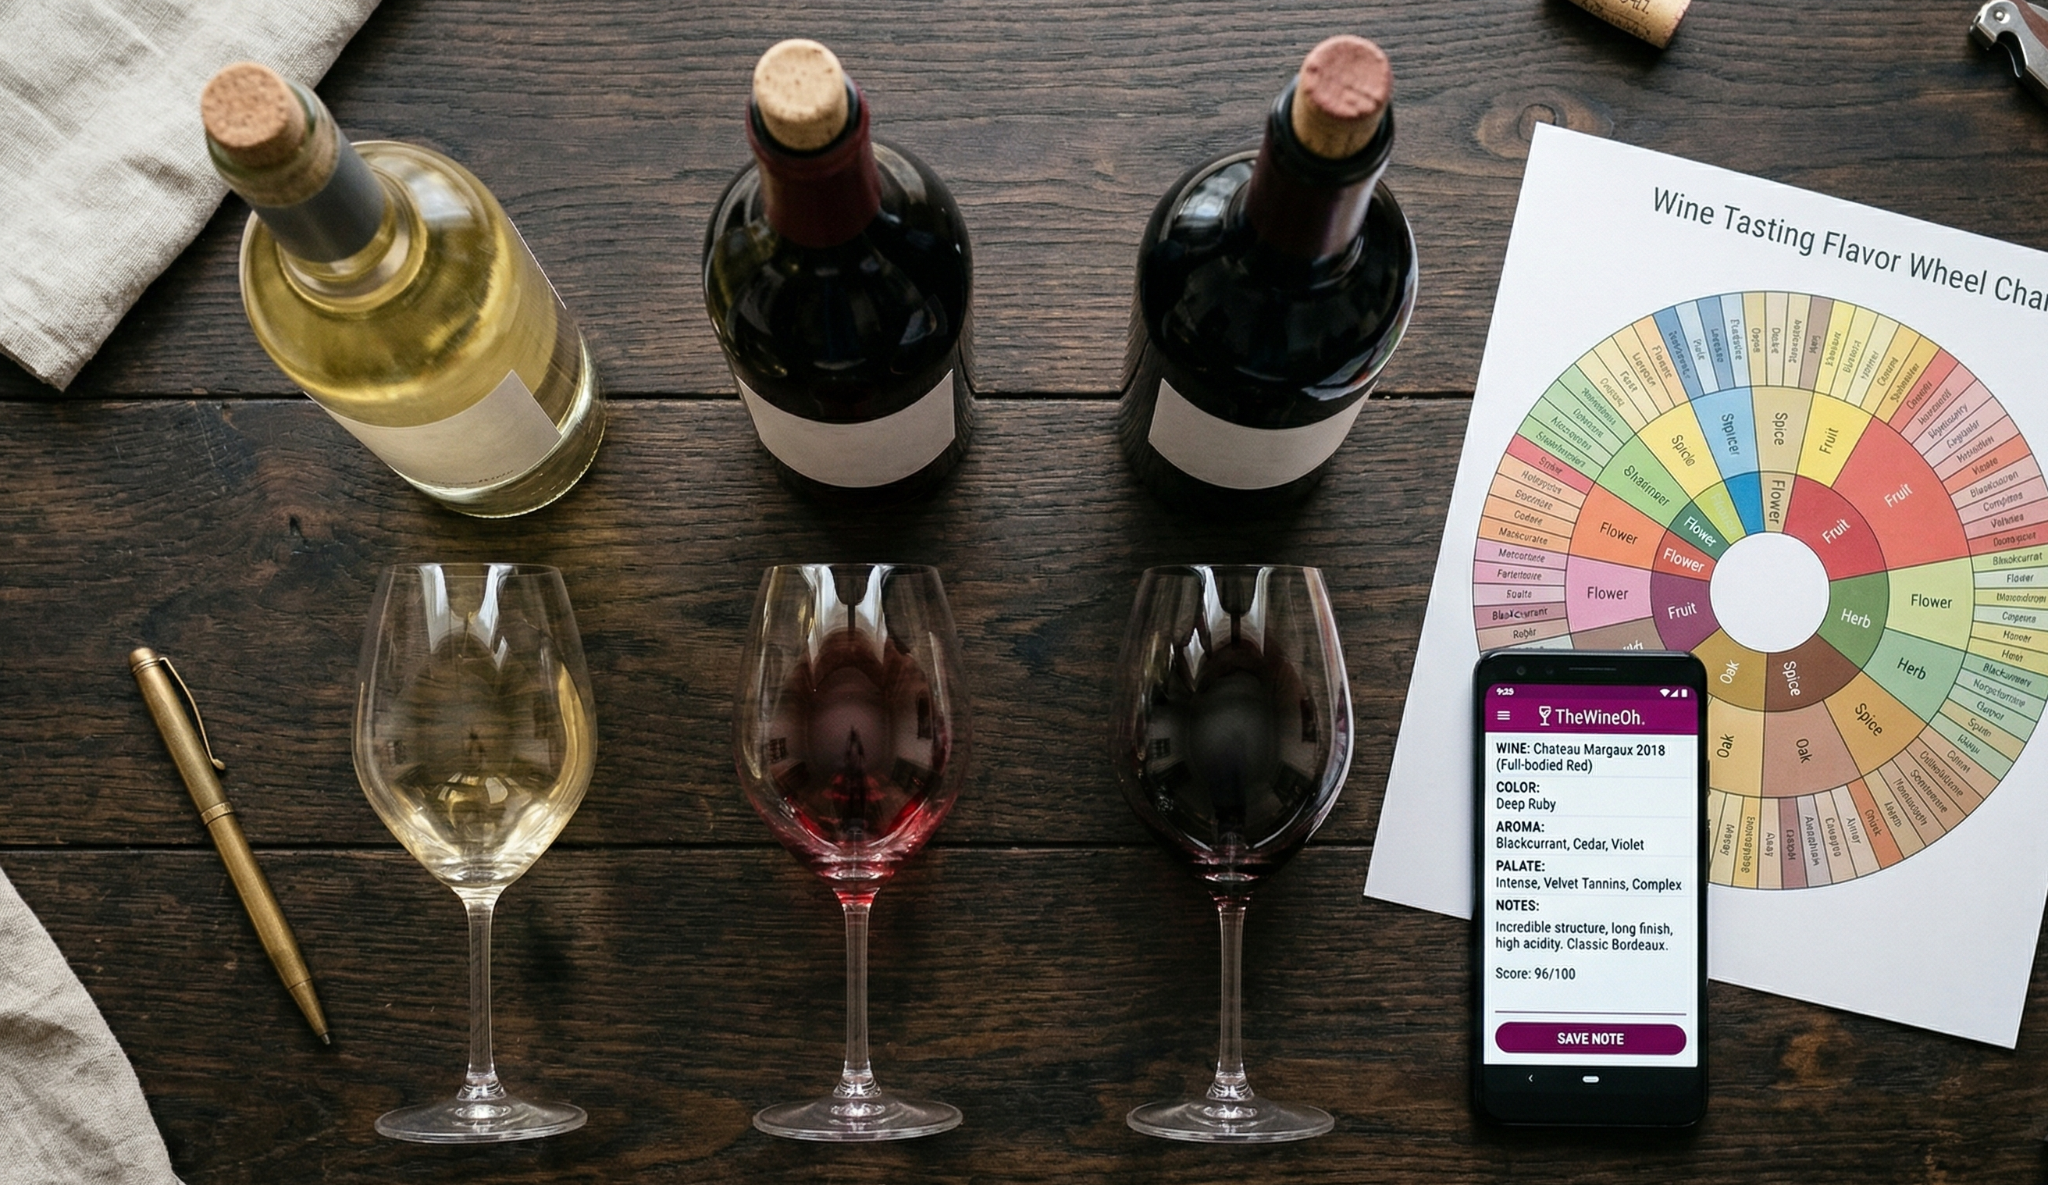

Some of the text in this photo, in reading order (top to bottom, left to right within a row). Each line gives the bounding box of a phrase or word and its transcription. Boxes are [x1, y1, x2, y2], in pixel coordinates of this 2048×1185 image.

[1653, 187, 1715, 227] Wine
[1724, 205, 1816, 257] Tasting
[1823, 231, 1901, 273] Flavor
[1910, 253, 1988, 296] Wheel
[1772, 412, 1788, 446] Spice
[1820, 427, 1838, 455] Fruit
[1769, 479, 1785, 525] Flower
[1884, 482, 1913, 508] Fruit
[1600, 522, 1638, 545] Flower
[1683, 515, 1717, 547] Flower
[1822, 518, 1851, 544] Fruit
[1663, 547, 1705, 573] Flower
[1587, 586, 1628, 600] Flower
[1911, 594, 1953, 609] Flower
[1668, 602, 1697, 620] Fruit
[1840, 609, 1871, 629] Herb
[1719, 659, 1740, 685] Oak
[1897, 657, 1927, 680] Herb
[1783, 660, 1801, 697] Spice
[1554, 708, 1646, 726] TheWineOh.
[1854, 703, 1883, 737] Spice
[1495, 742, 1666, 759] WINE: Chateau Margaux 2018
[1716, 733, 1735, 759] Oak
[1796, 738, 1812, 764] Oak
[1496, 757, 1593, 775] (Full-bodied Red)
[1495, 780, 1540, 794] COLOR:
[1496, 796, 1557, 813] Deep Ruby
[1495, 820, 1545, 833] AROMA:
[1496, 836, 1645, 852] Blackcurrant, Cedar, Violet
[1495, 859, 1546, 873] PALATE:
[1495, 876, 1682, 894] Intense, Velvet Tannins, Complex
[1495, 899, 1540, 912] NOTES:
[1495, 920, 1674, 938] Incredible structure, long finish,
[1495, 936, 1669, 953] high acidity. Classic Bordeaux.
[1495, 966, 1576, 981] Score: 96/100
[1557, 1032, 1625, 1045] SAVE NOTE
